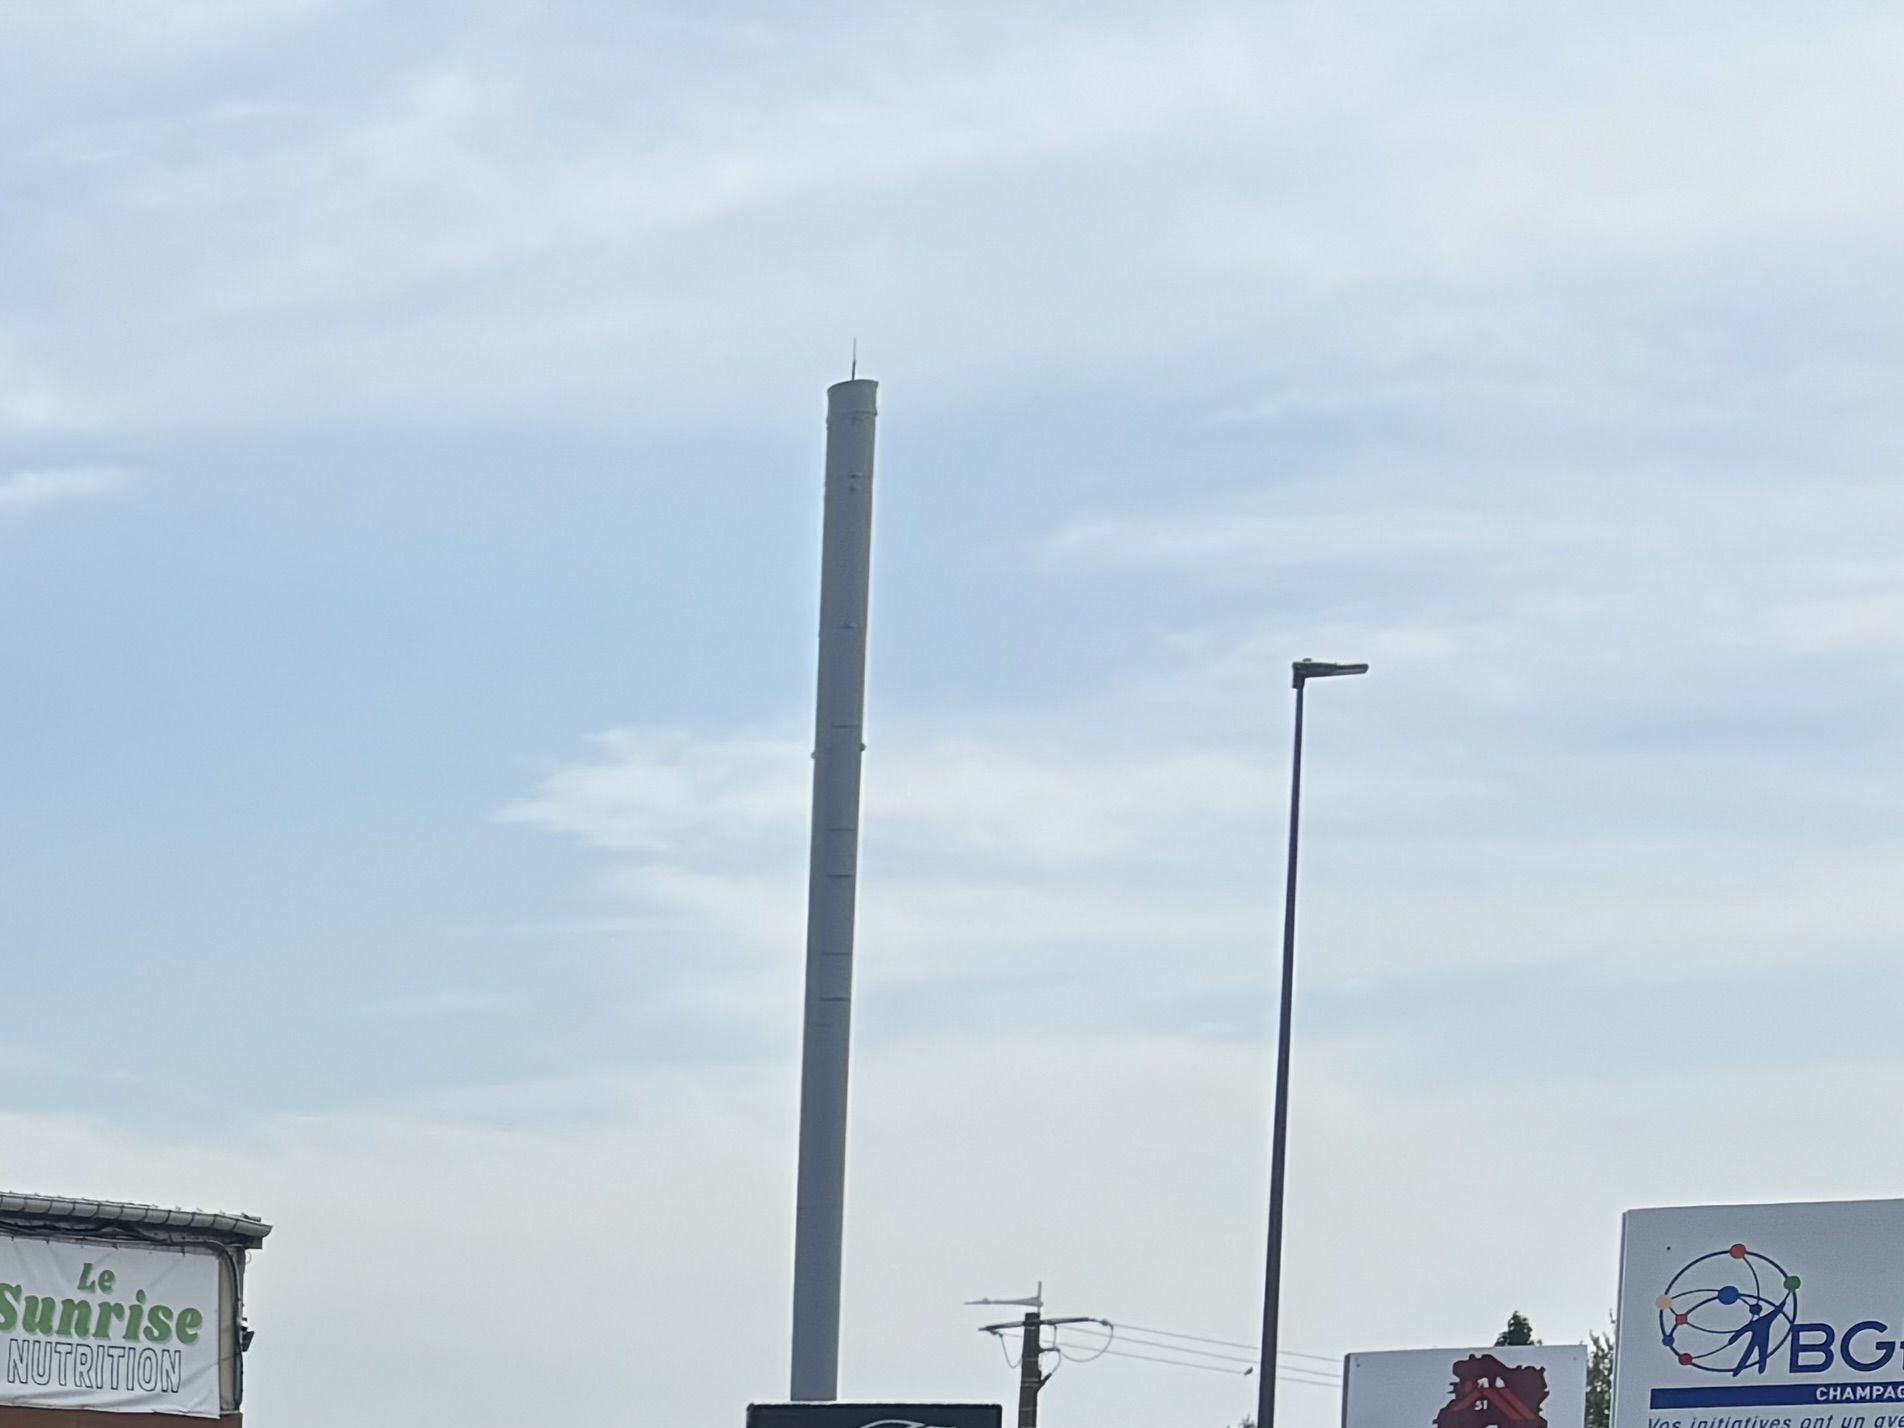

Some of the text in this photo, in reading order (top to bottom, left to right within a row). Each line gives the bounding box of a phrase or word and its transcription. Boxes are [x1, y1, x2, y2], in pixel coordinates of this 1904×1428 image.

[77, 1262, 117, 1293] Le
[7, 1338, 182, 1394] NUTRITION
[1789, 1320, 1904, 1374] BG
[1474, 1399, 1488, 1411] 51
